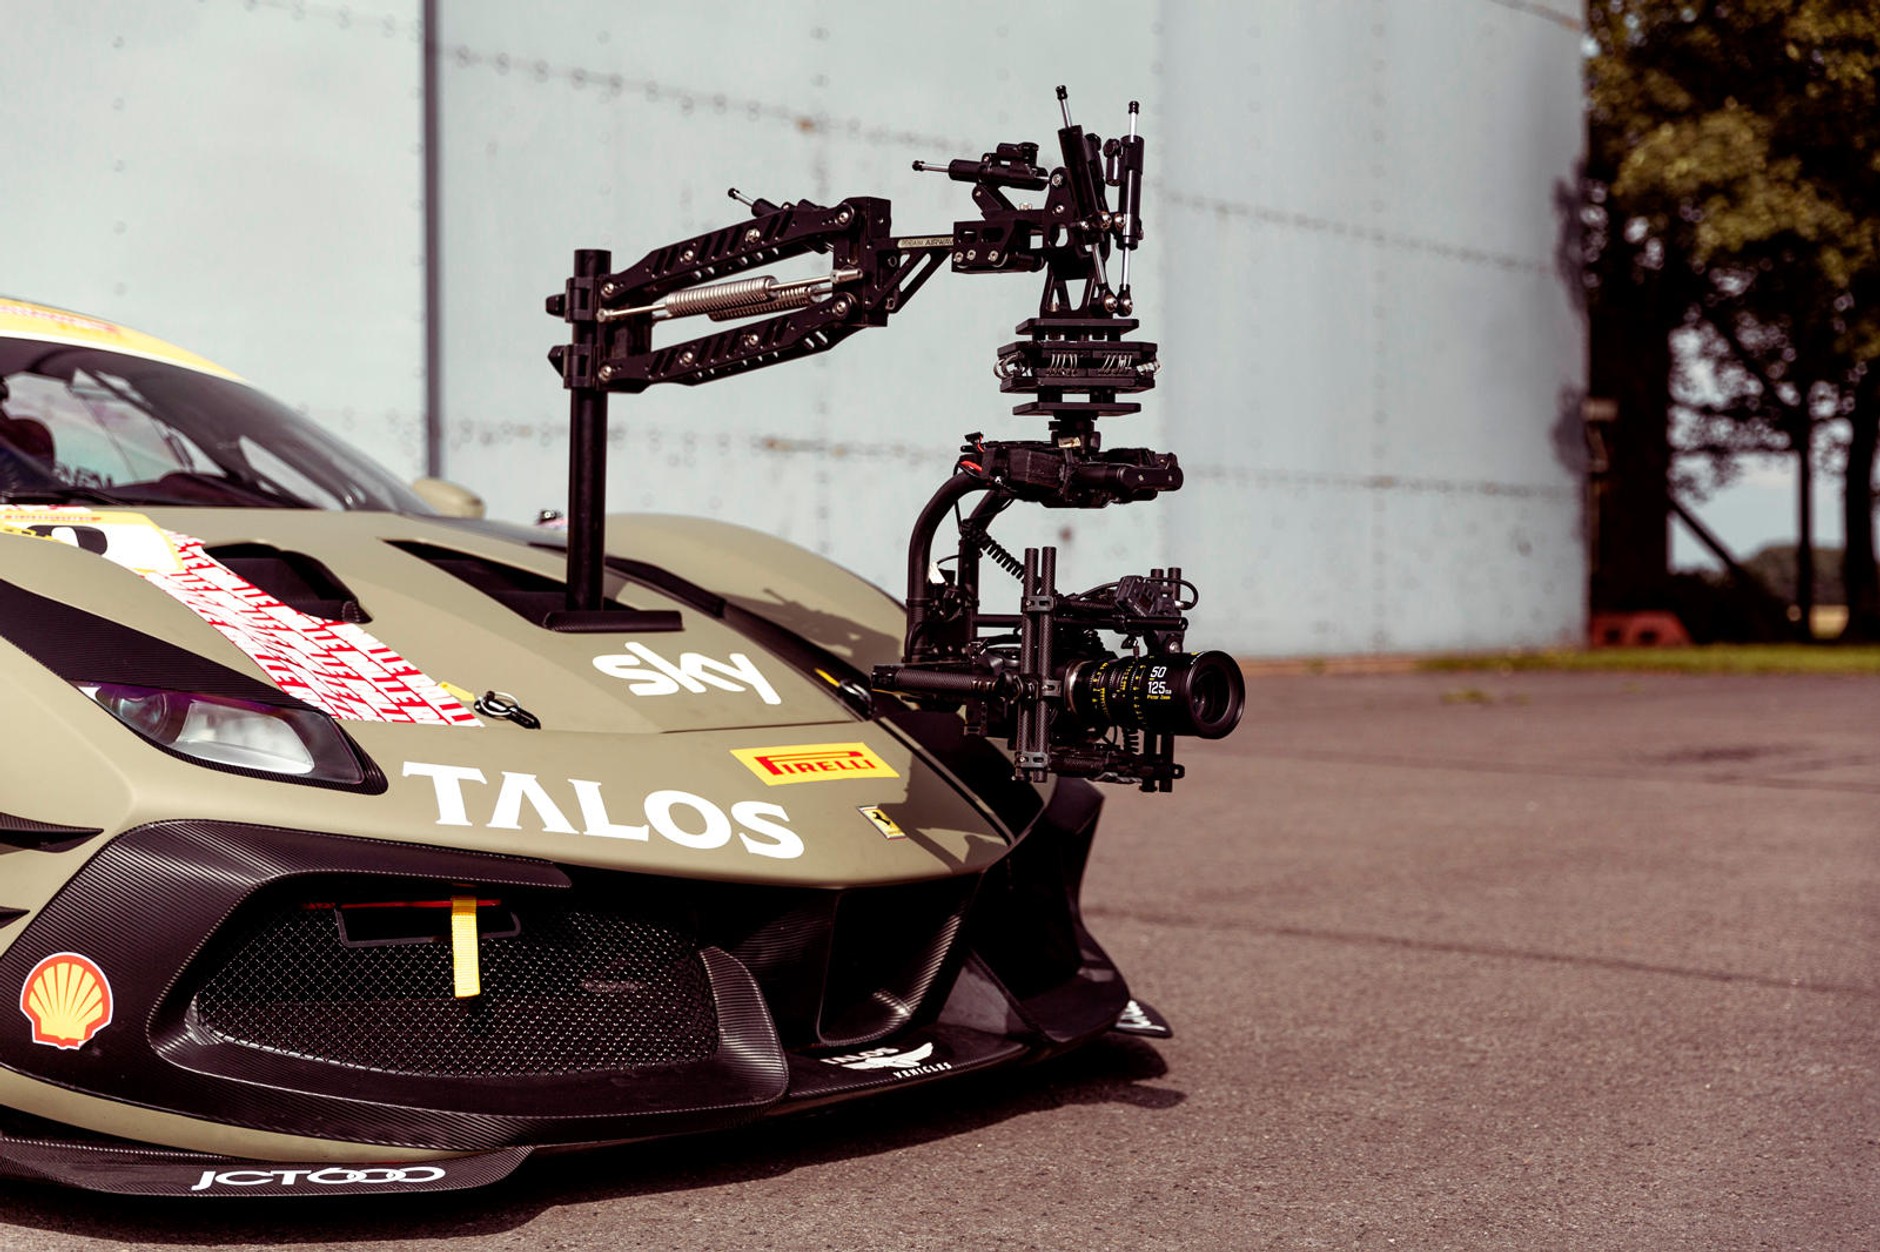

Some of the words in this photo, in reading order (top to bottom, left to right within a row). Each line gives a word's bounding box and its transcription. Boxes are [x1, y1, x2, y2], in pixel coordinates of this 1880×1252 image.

[593, 642, 781, 705] sky
[1150, 666, 1167, 678] 50
[754, 751, 877, 775] PIRELLI
[402, 761, 805, 859] TALOS
[893, 1061, 952, 1079] VEHICLES
[191, 1166, 446, 1191] JCT600
